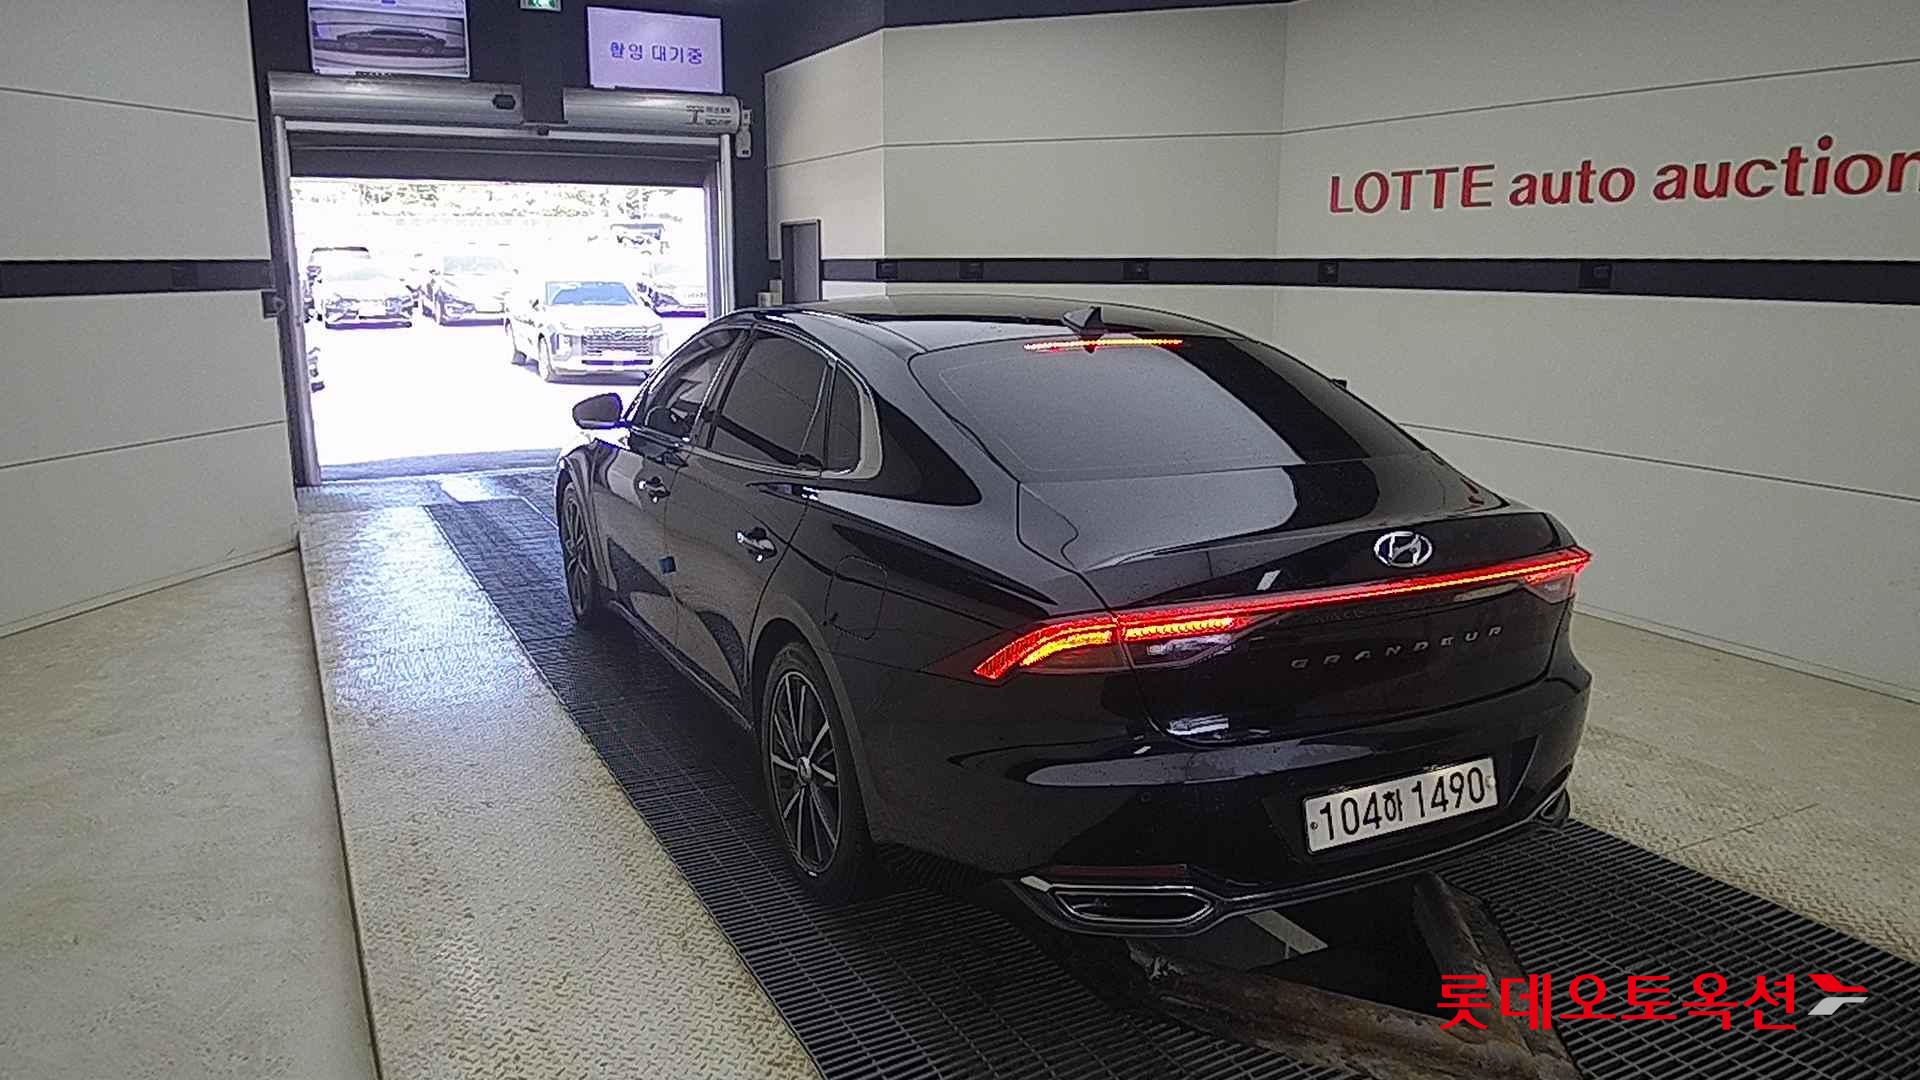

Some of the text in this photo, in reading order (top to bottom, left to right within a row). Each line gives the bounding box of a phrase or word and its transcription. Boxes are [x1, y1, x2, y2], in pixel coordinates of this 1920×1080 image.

[651, 45, 703, 65] 대기중
[1330, 163, 1495, 214] LOTTE
[1508, 160, 1636, 206] auto
[1290, 626, 1503, 668] GRANDEUR
[1412, 767, 1486, 818] 1490
